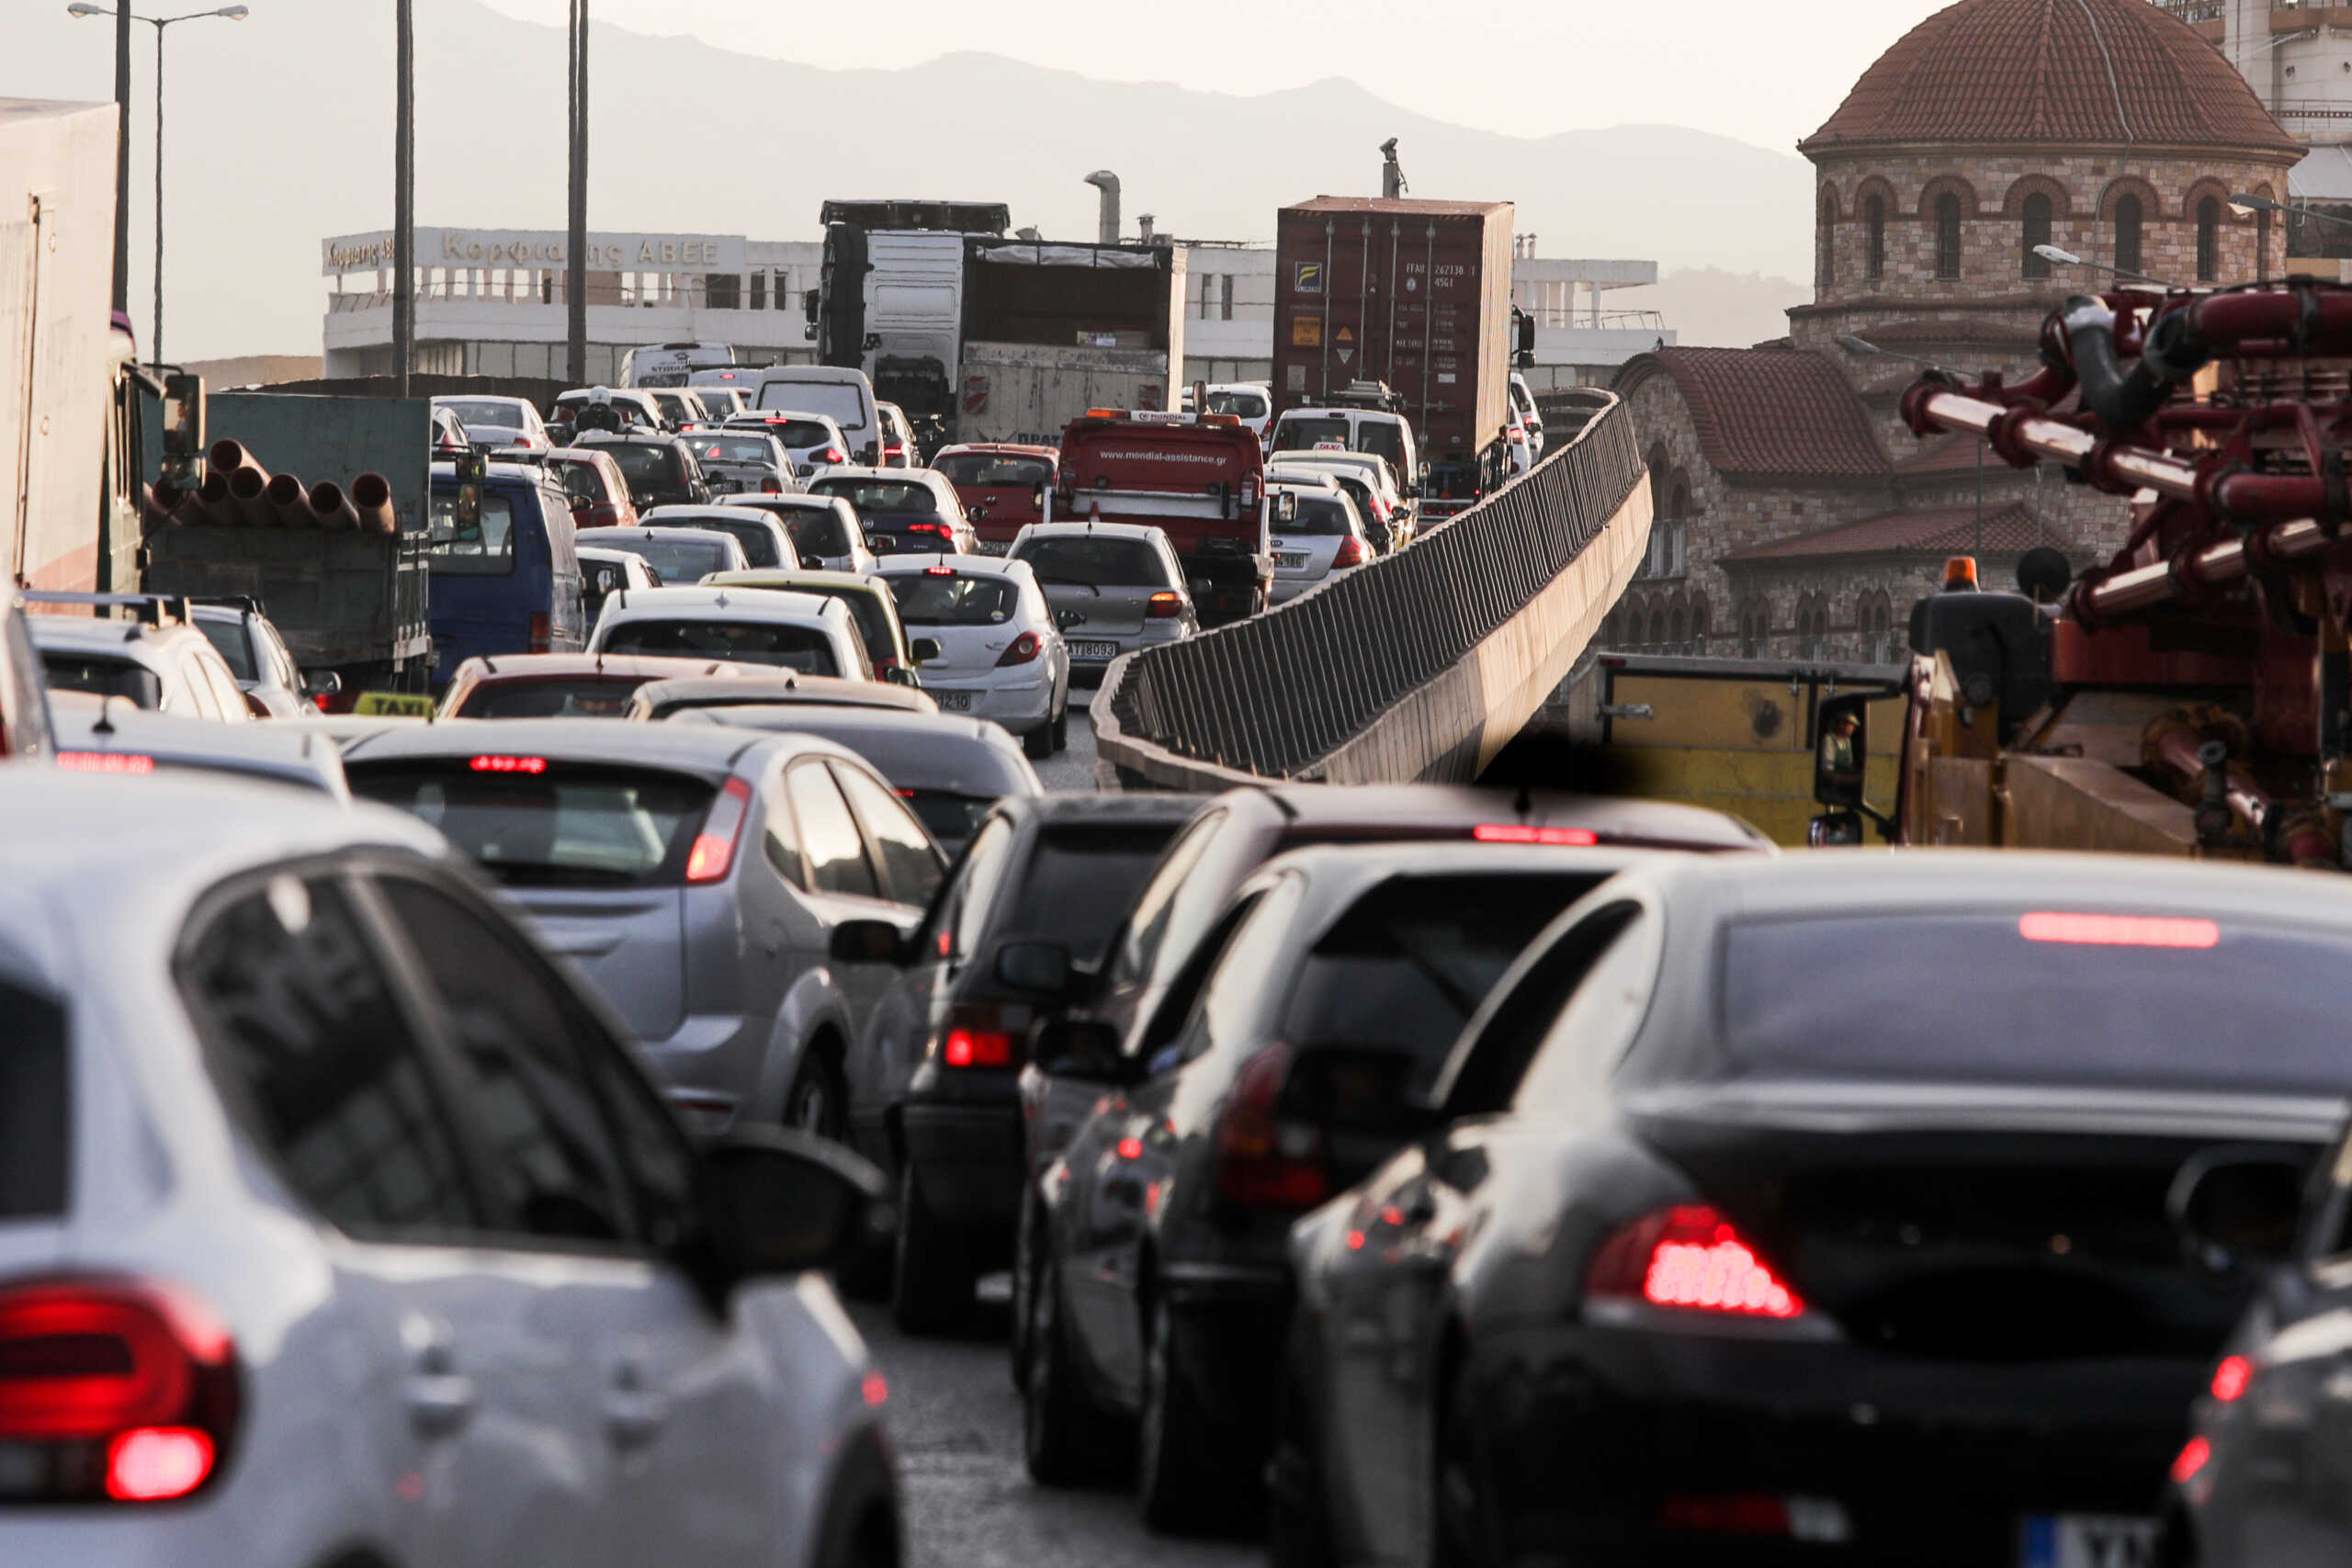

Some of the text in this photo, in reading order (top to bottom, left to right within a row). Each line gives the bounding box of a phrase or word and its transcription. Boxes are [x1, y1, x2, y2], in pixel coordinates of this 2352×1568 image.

[443, 234, 624, 265] Κορφιαης
[1100, 450, 1227, 466] www.mondial-assistance.gr
[373, 697, 424, 716] TAXI
